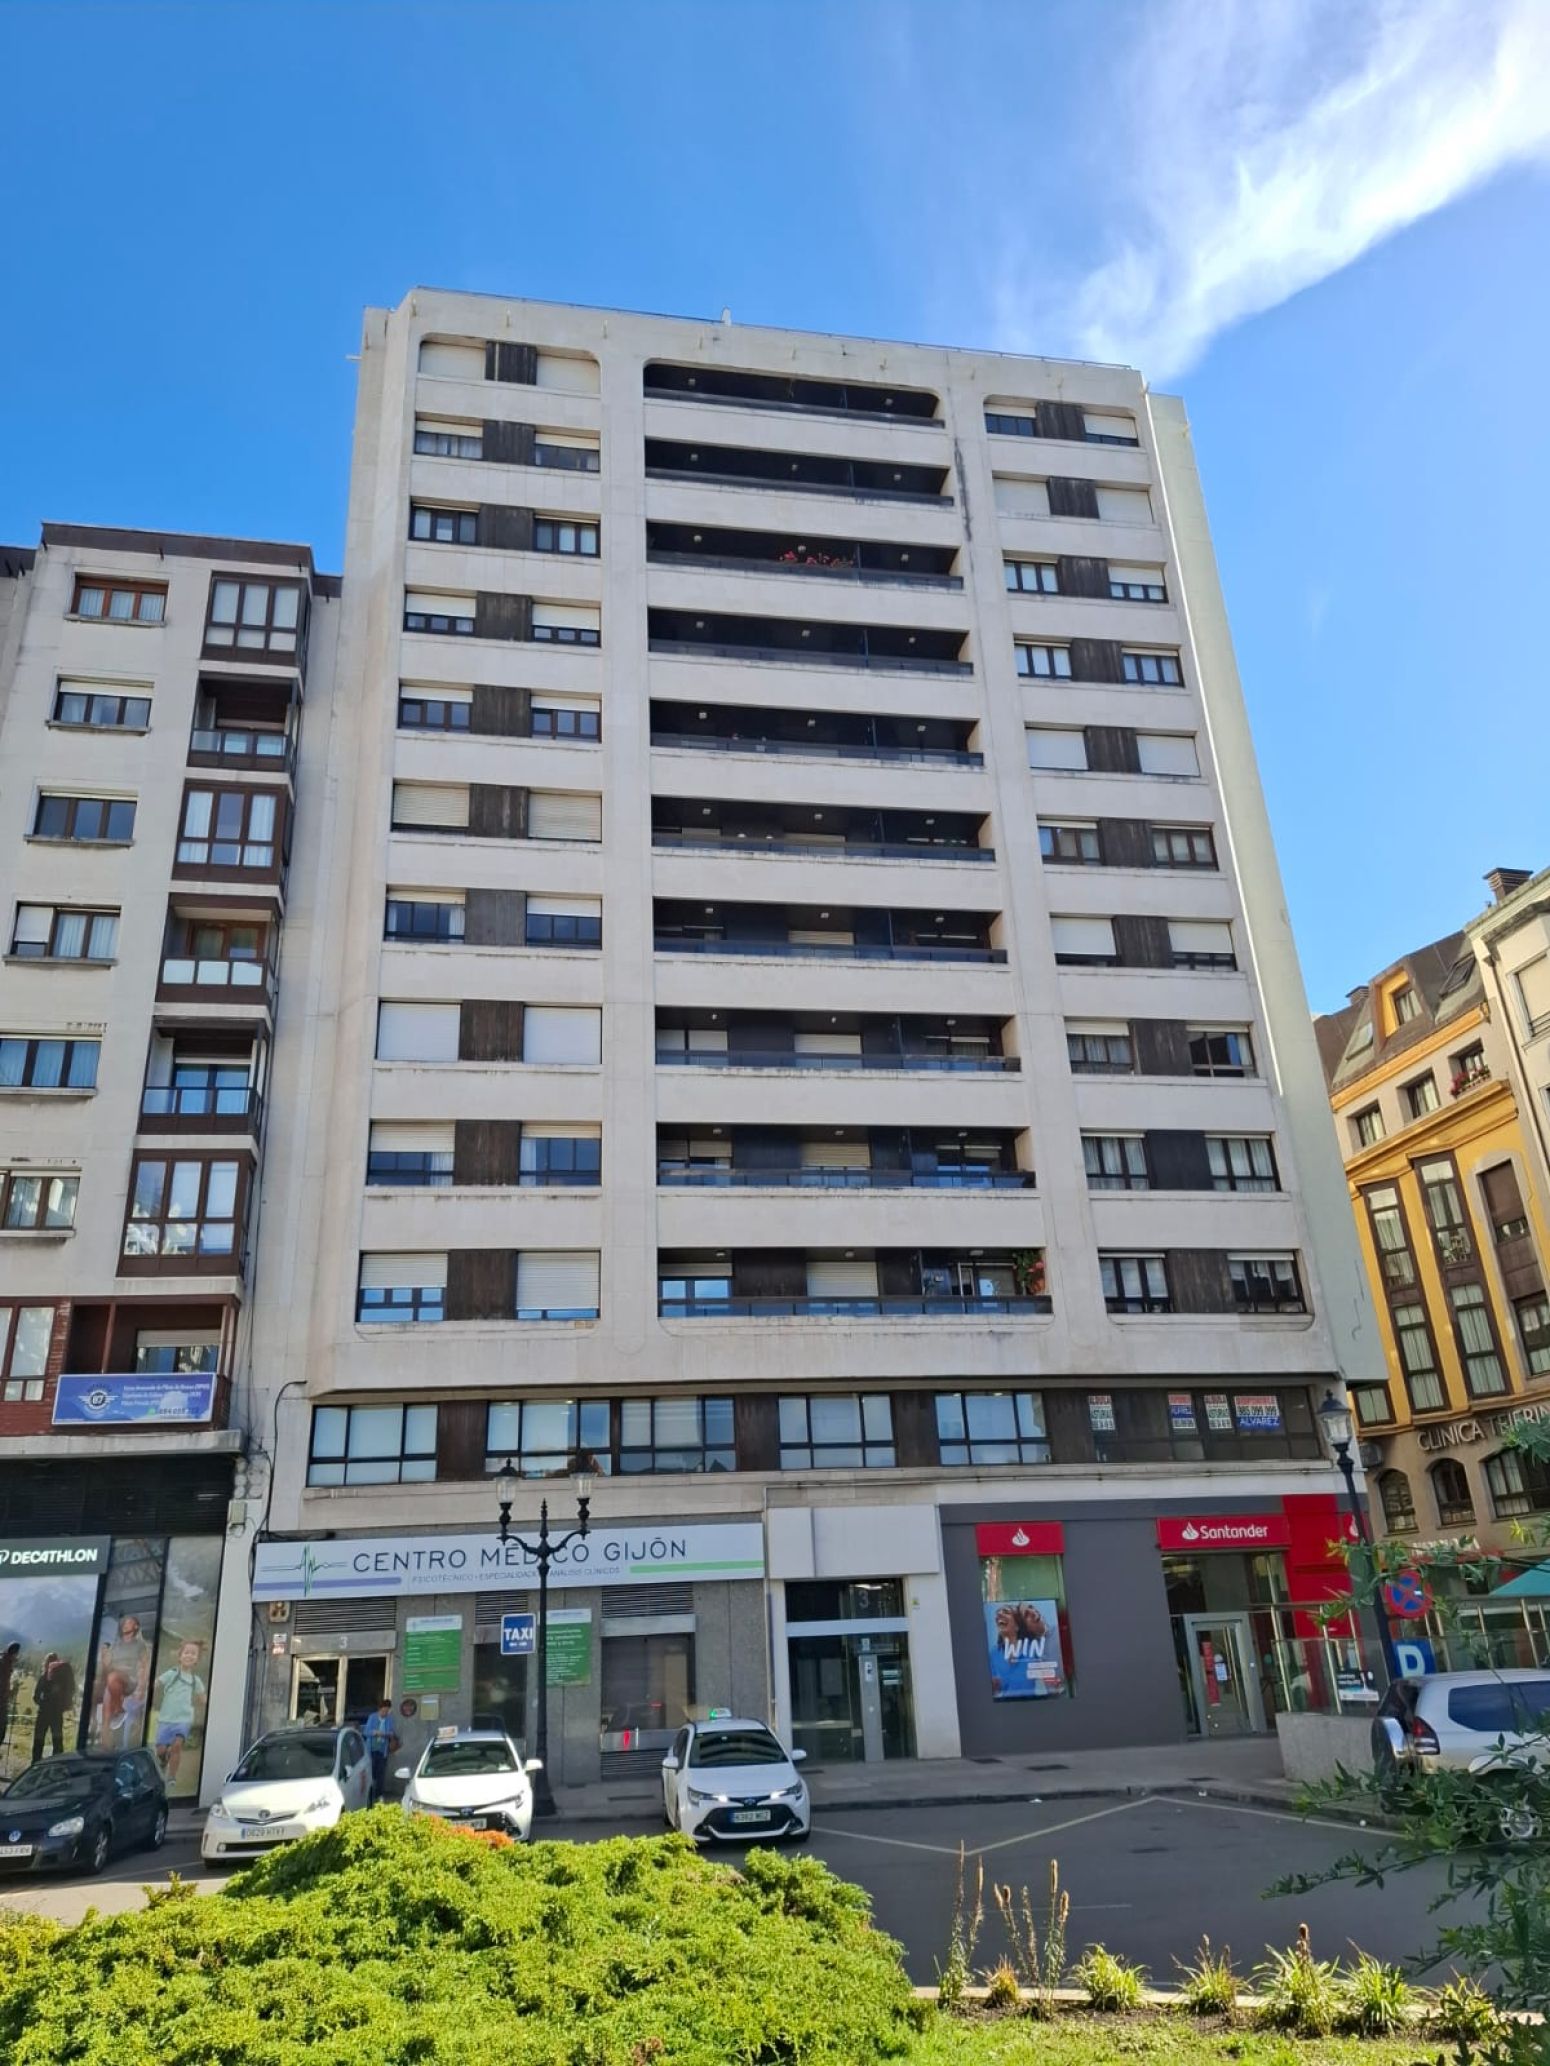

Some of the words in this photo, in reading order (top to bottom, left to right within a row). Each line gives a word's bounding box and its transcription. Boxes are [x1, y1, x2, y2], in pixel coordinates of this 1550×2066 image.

[1200, 1523, 1268, 1539] Santander
[10, 1547, 98, 1565] DECATHLON
[353, 1549, 467, 1573] CENTRO
[481, 1542, 590, 1567] MÉDCO
[604, 1537, 687, 1561] GIJÓN
[340, 1635, 348, 1649] 3
[504, 1626, 533, 1641] TAXI
[1003, 1635, 1046, 1661] WIN
